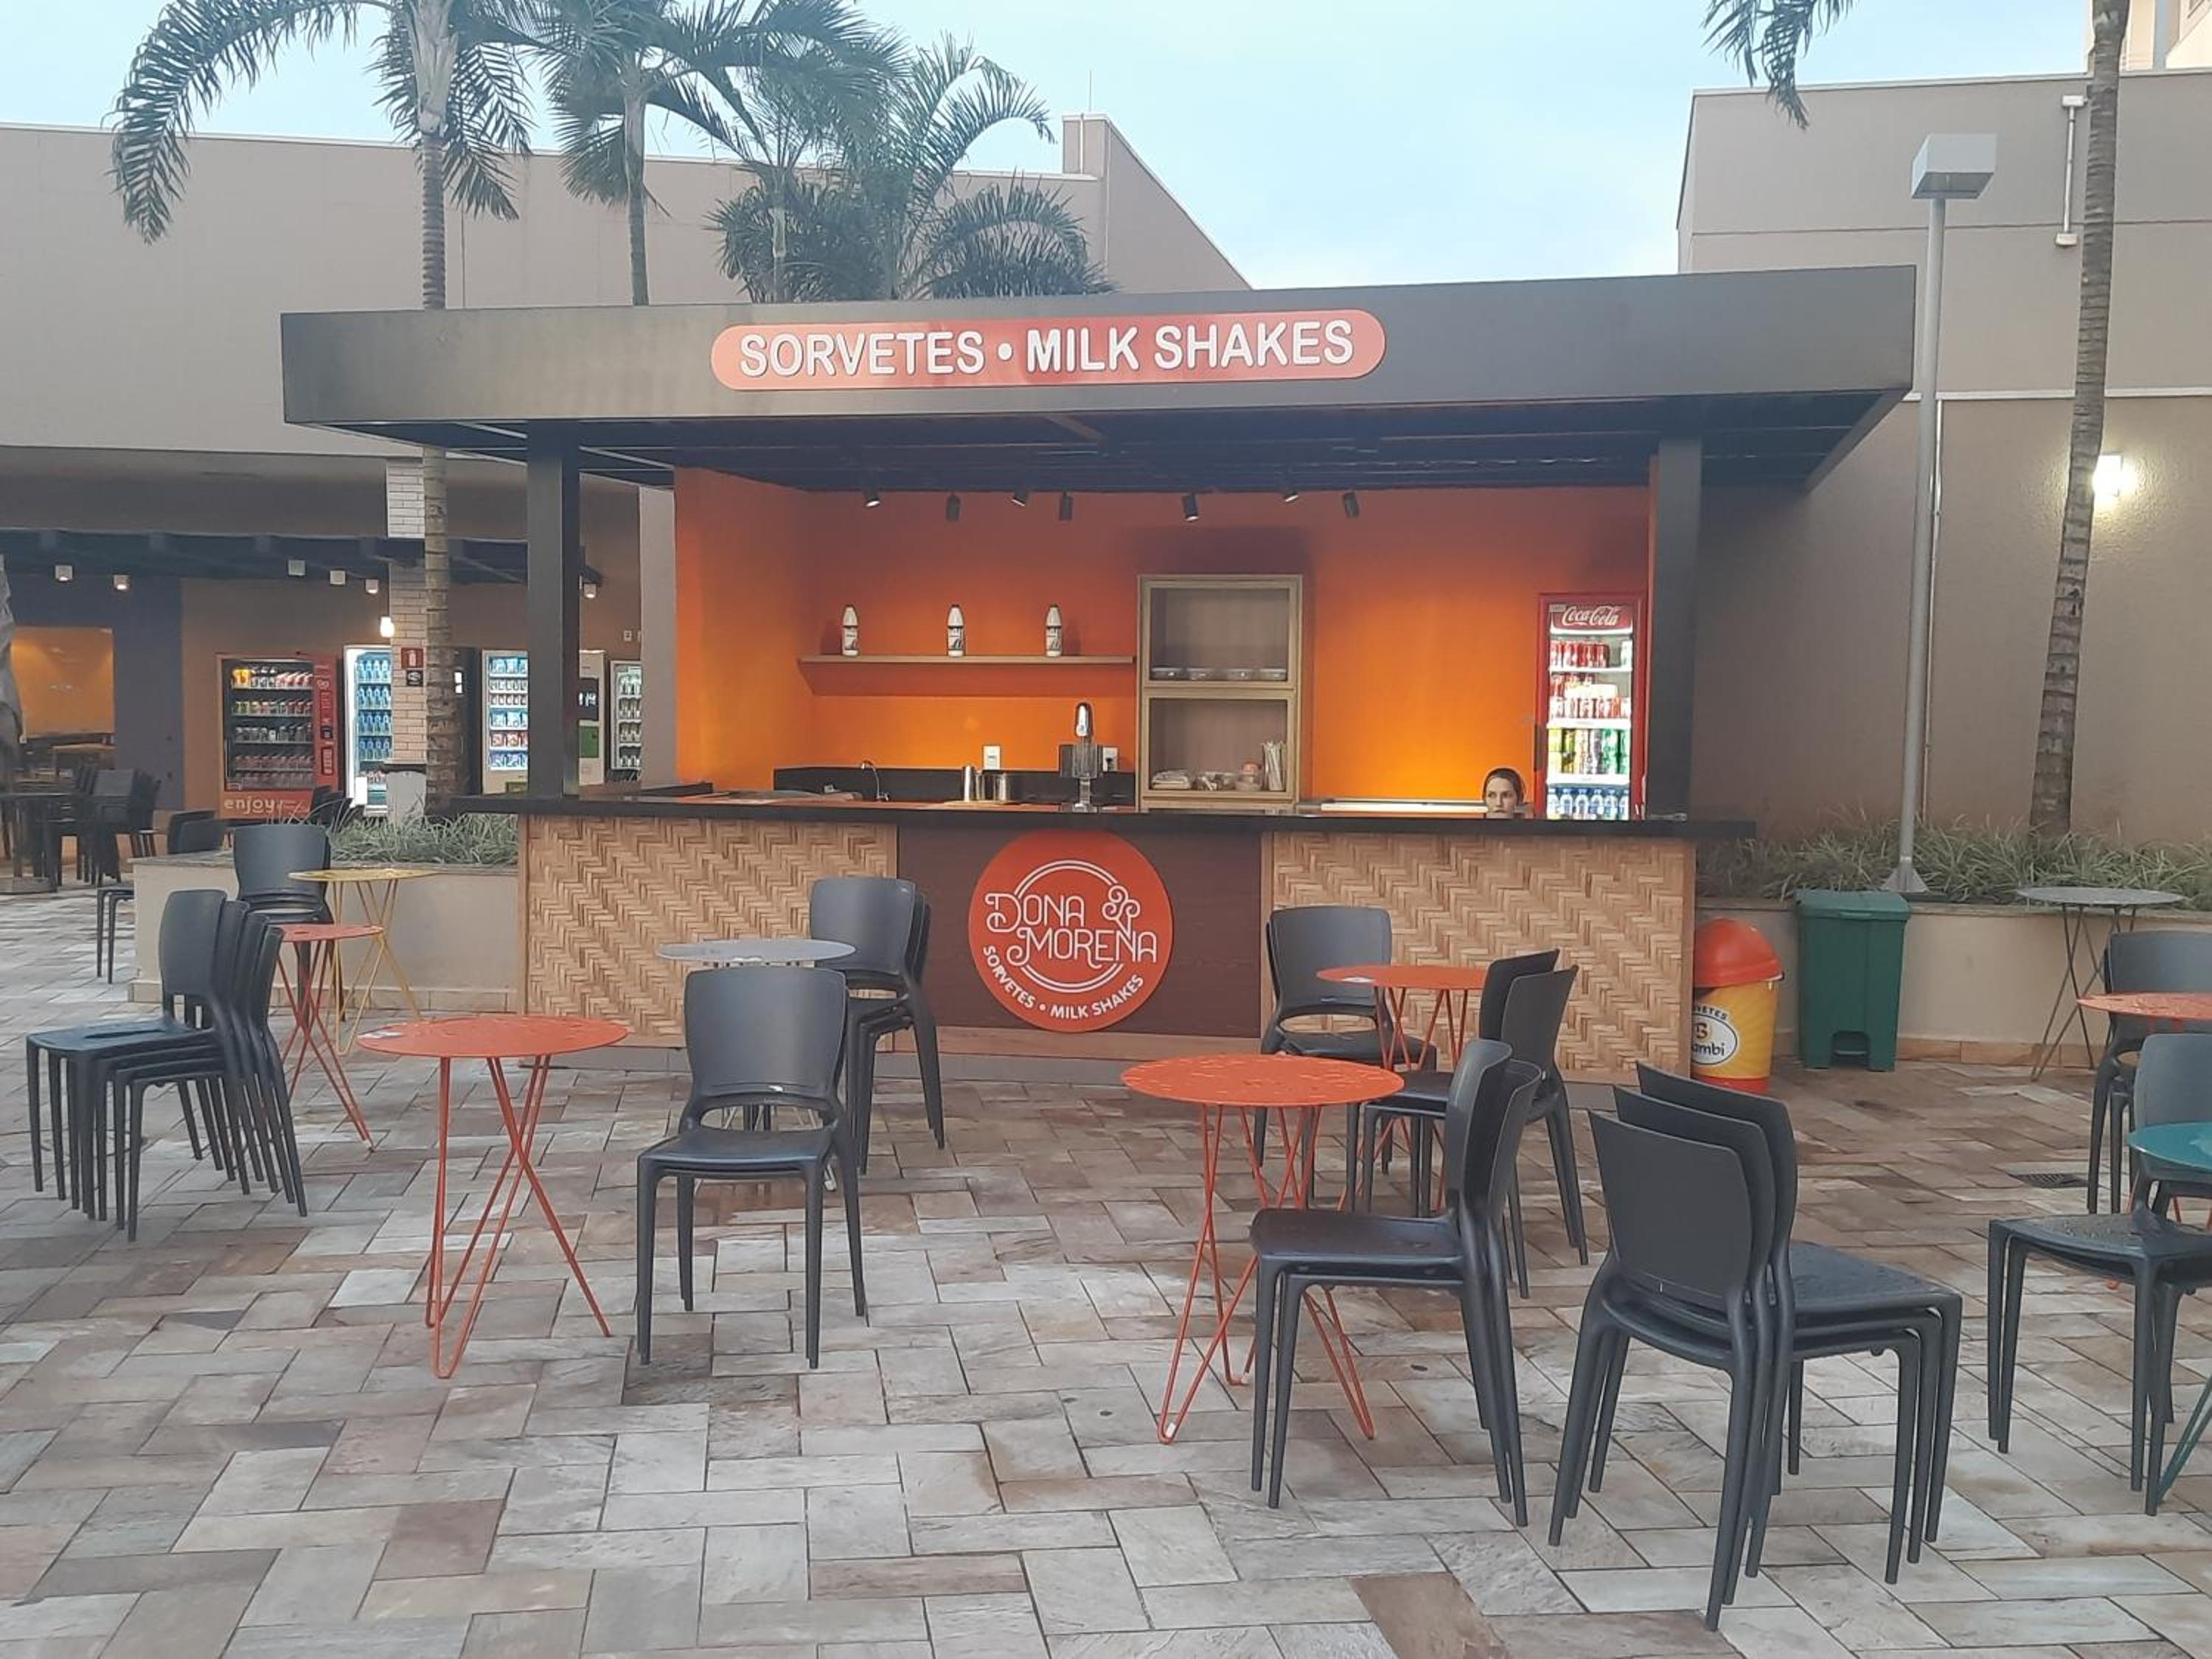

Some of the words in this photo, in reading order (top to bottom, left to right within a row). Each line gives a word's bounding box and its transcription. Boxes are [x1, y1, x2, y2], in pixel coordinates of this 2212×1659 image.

[740, 333, 985, 378] SORVETES
[1026, 324, 1140, 372] MILK
[1155, 319, 1356, 367] SHAKES
[985, 893, 1085, 932] DONA
[1006, 927, 1157, 969] MORENA
[983, 945, 1036, 1009] SORVETES
[1050, 1004, 1088, 1019] MILK
[1091, 974, 1144, 1015] SHAKES
[1692, 1042, 1725, 1056] ambi
